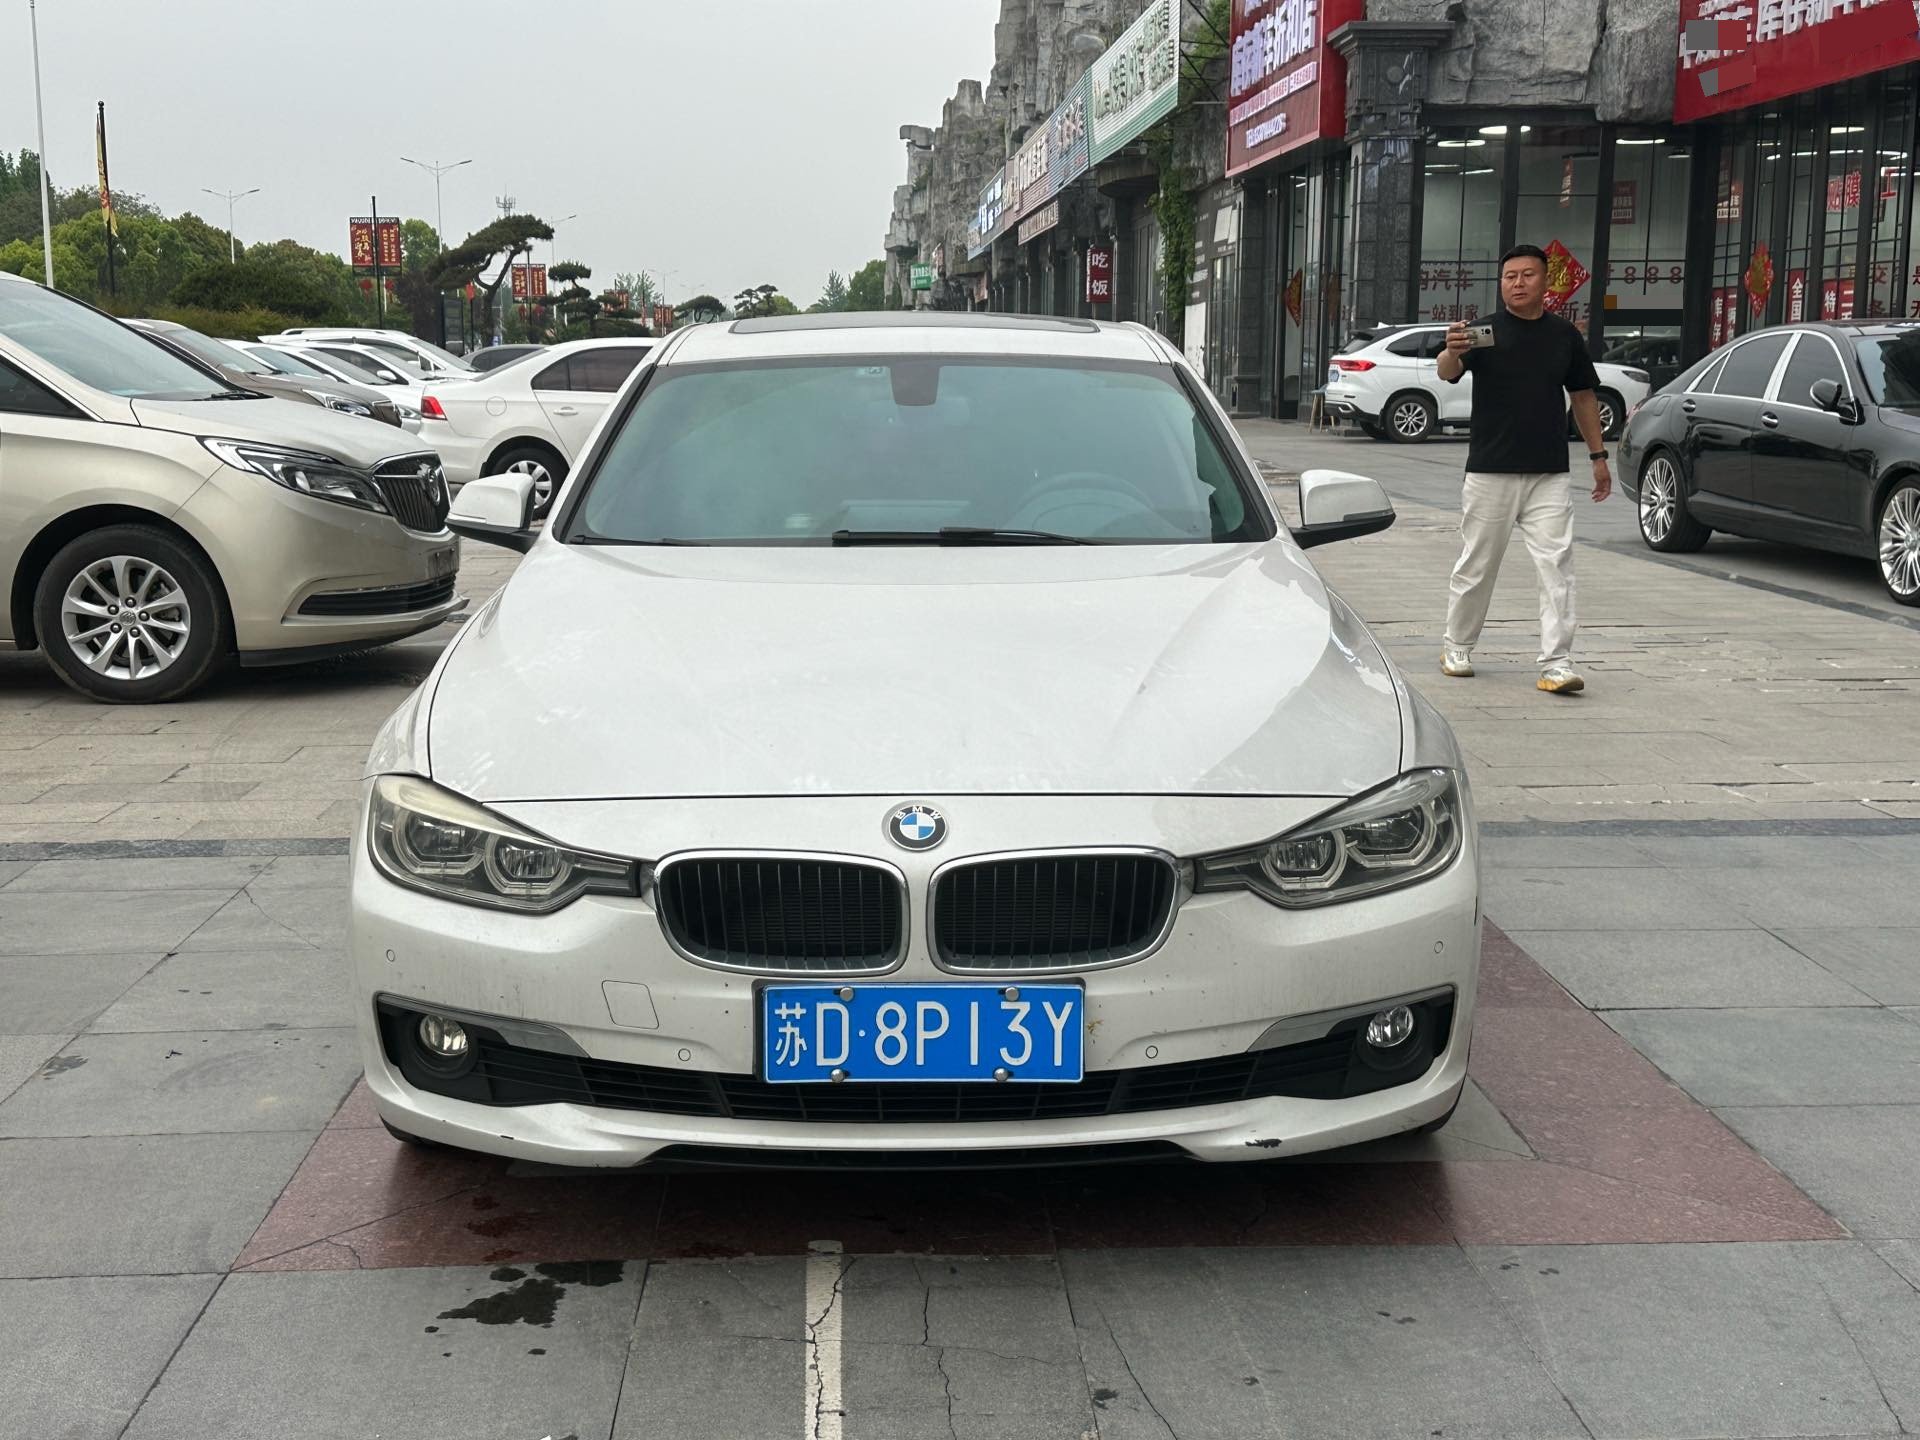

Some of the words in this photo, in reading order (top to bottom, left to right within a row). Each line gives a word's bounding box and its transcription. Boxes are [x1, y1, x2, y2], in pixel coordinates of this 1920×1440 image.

[1091, 252, 1109, 296] 吃饭
[1418, 303, 1479, 322] 一站到家
[1712, 296, 1723, 351] 库存
[895, 804, 942, 820] BMW
[774, 1001, 1074, 1067] 苏D·8P13Y
